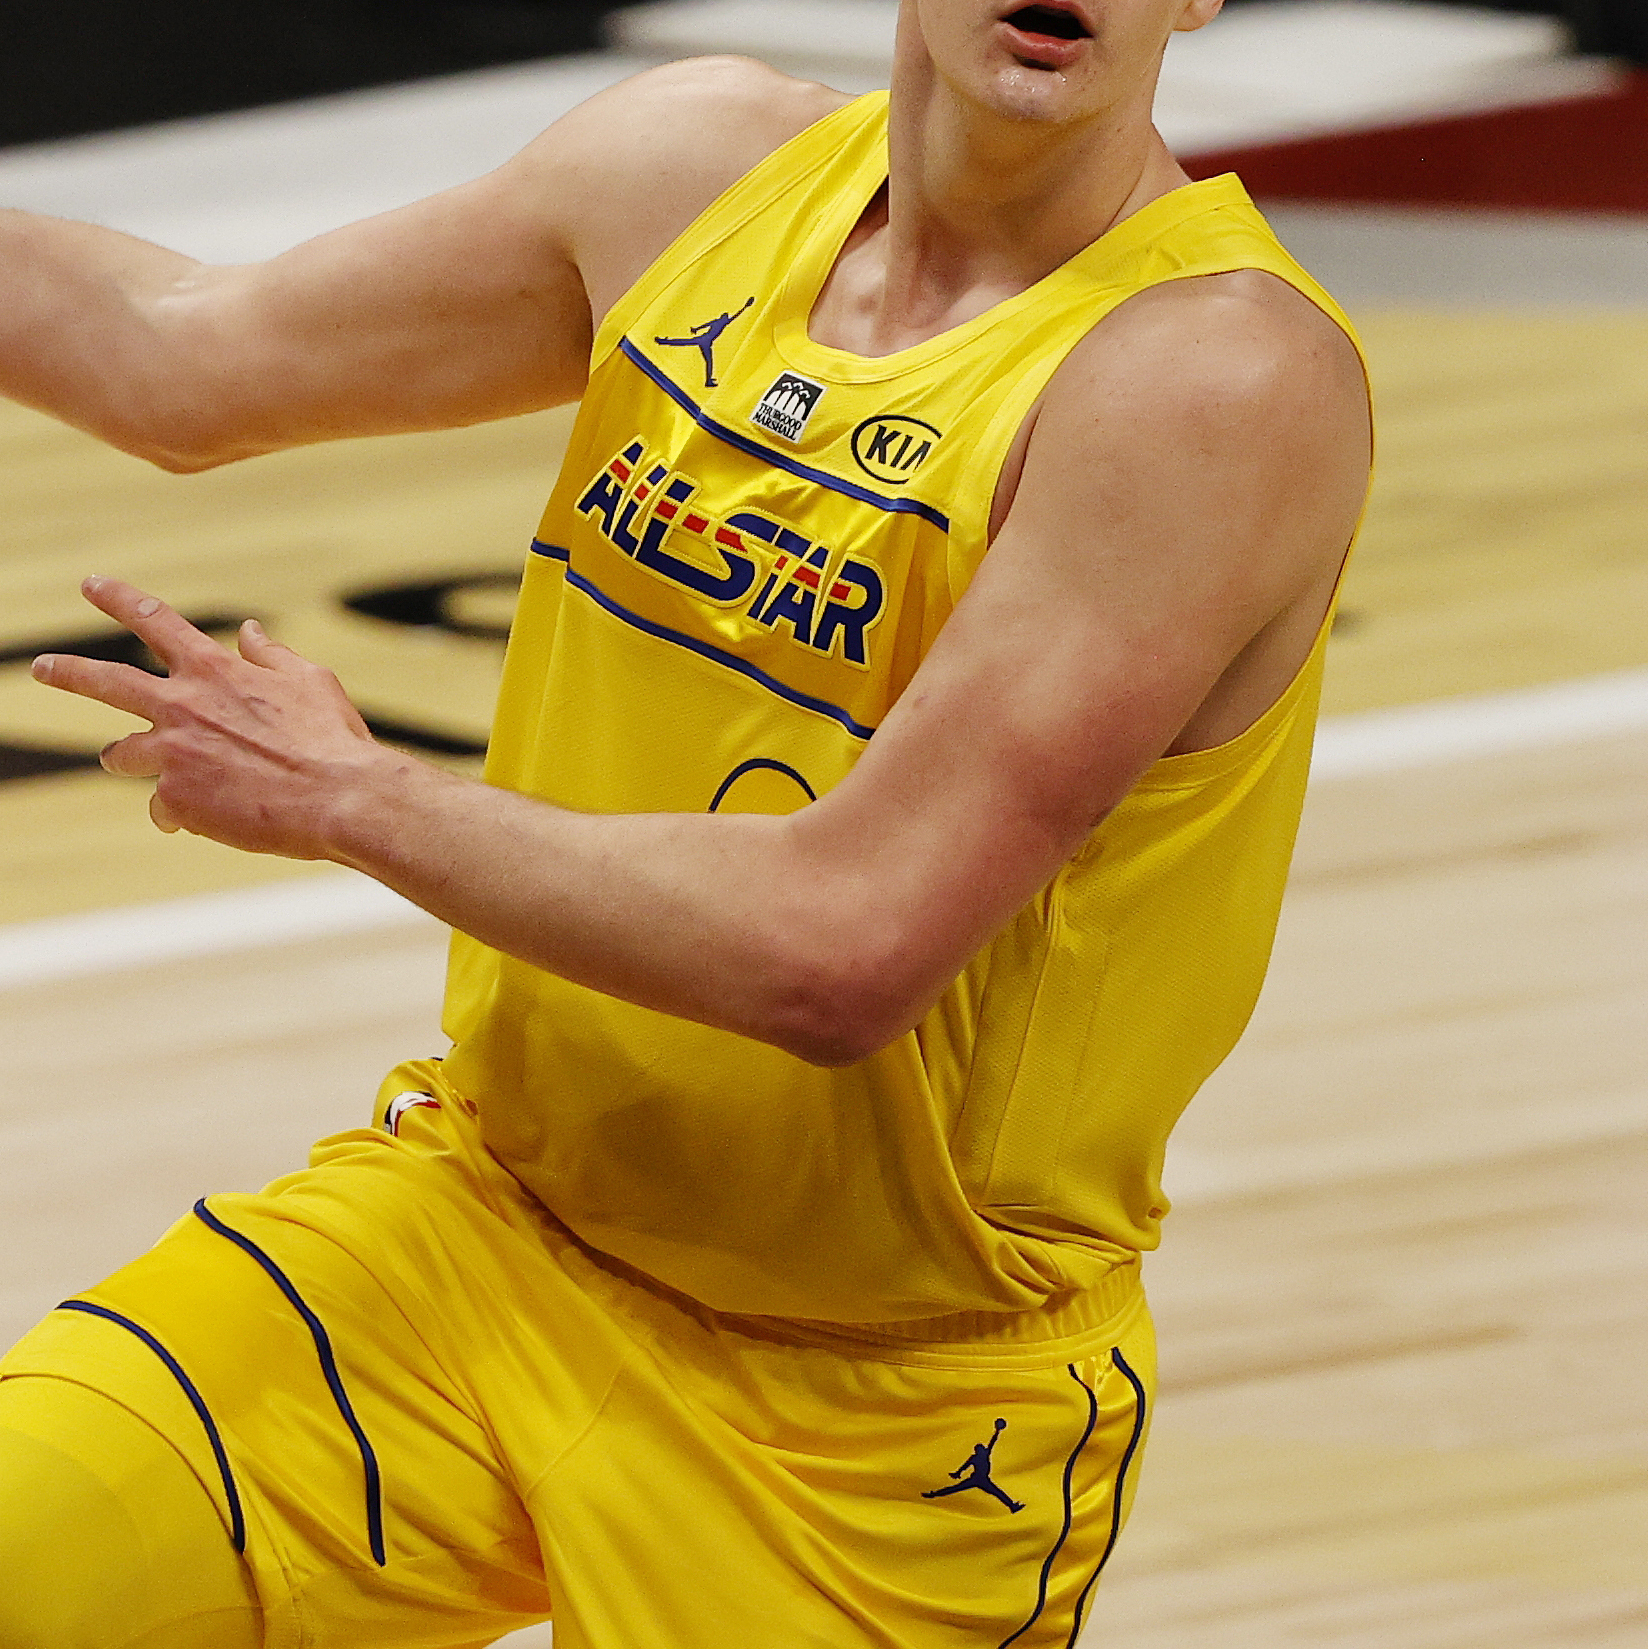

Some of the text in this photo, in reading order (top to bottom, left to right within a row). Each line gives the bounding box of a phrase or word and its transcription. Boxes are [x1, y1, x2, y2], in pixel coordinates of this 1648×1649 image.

[752, 412, 796, 440] MARSHALL
[761, 402, 802, 430] THURGOOD
[864, 424, 932, 471] KIA
